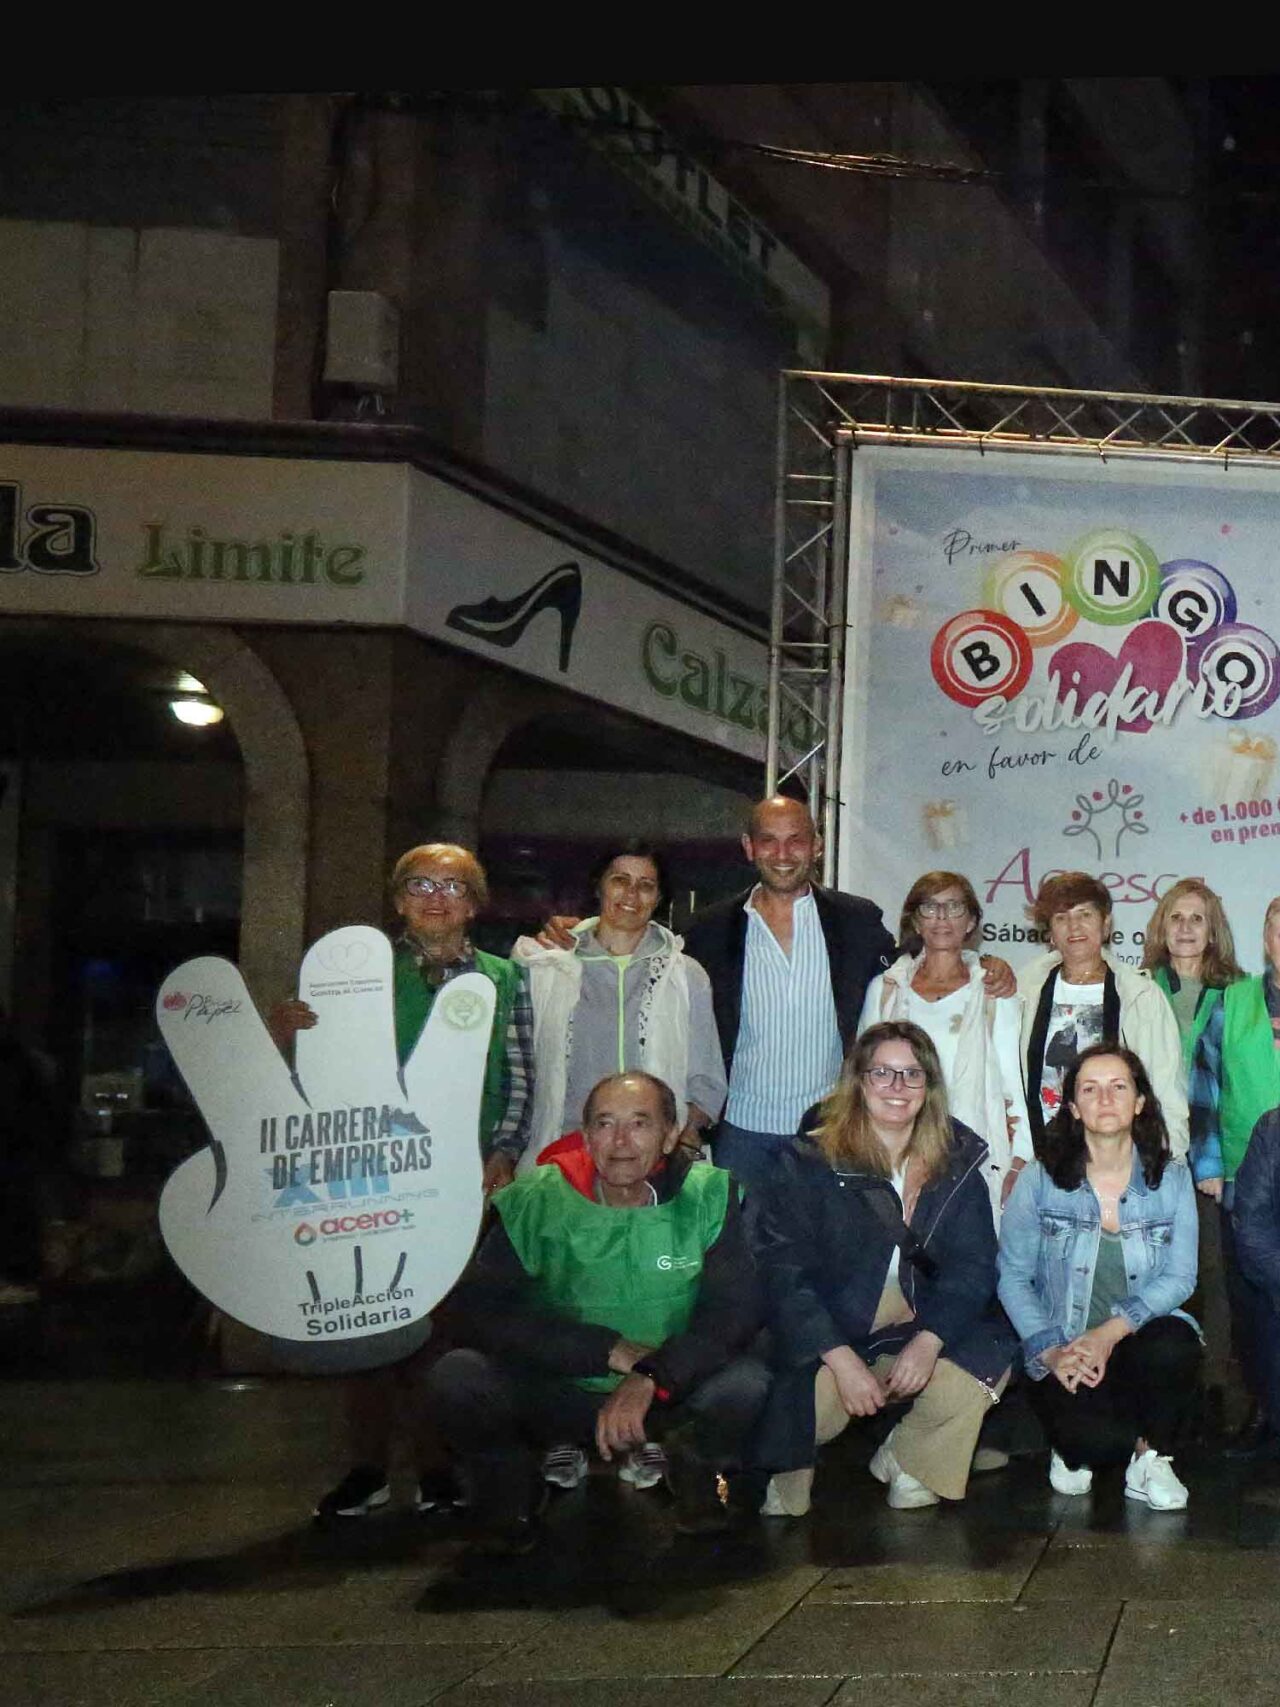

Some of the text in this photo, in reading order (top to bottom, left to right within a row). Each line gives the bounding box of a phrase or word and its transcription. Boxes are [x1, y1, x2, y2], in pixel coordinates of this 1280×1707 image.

[138, 521, 369, 584] Limite
[943, 529, 1021, 566] Primer
[960, 558, 1257, 690] BINGO
[973, 661, 1242, 742] solidario
[942, 732, 1103, 779] en favor de
[1192, 806, 1216, 825] de
[1220, 799, 1273, 822] 1.000
[1211, 828, 1235, 843] en
[260, 1105, 393, 1153] II CARRERA
[273, 1136, 432, 1190] DE EMPRESAS
[307, 1306, 411, 1336] Solidaria
